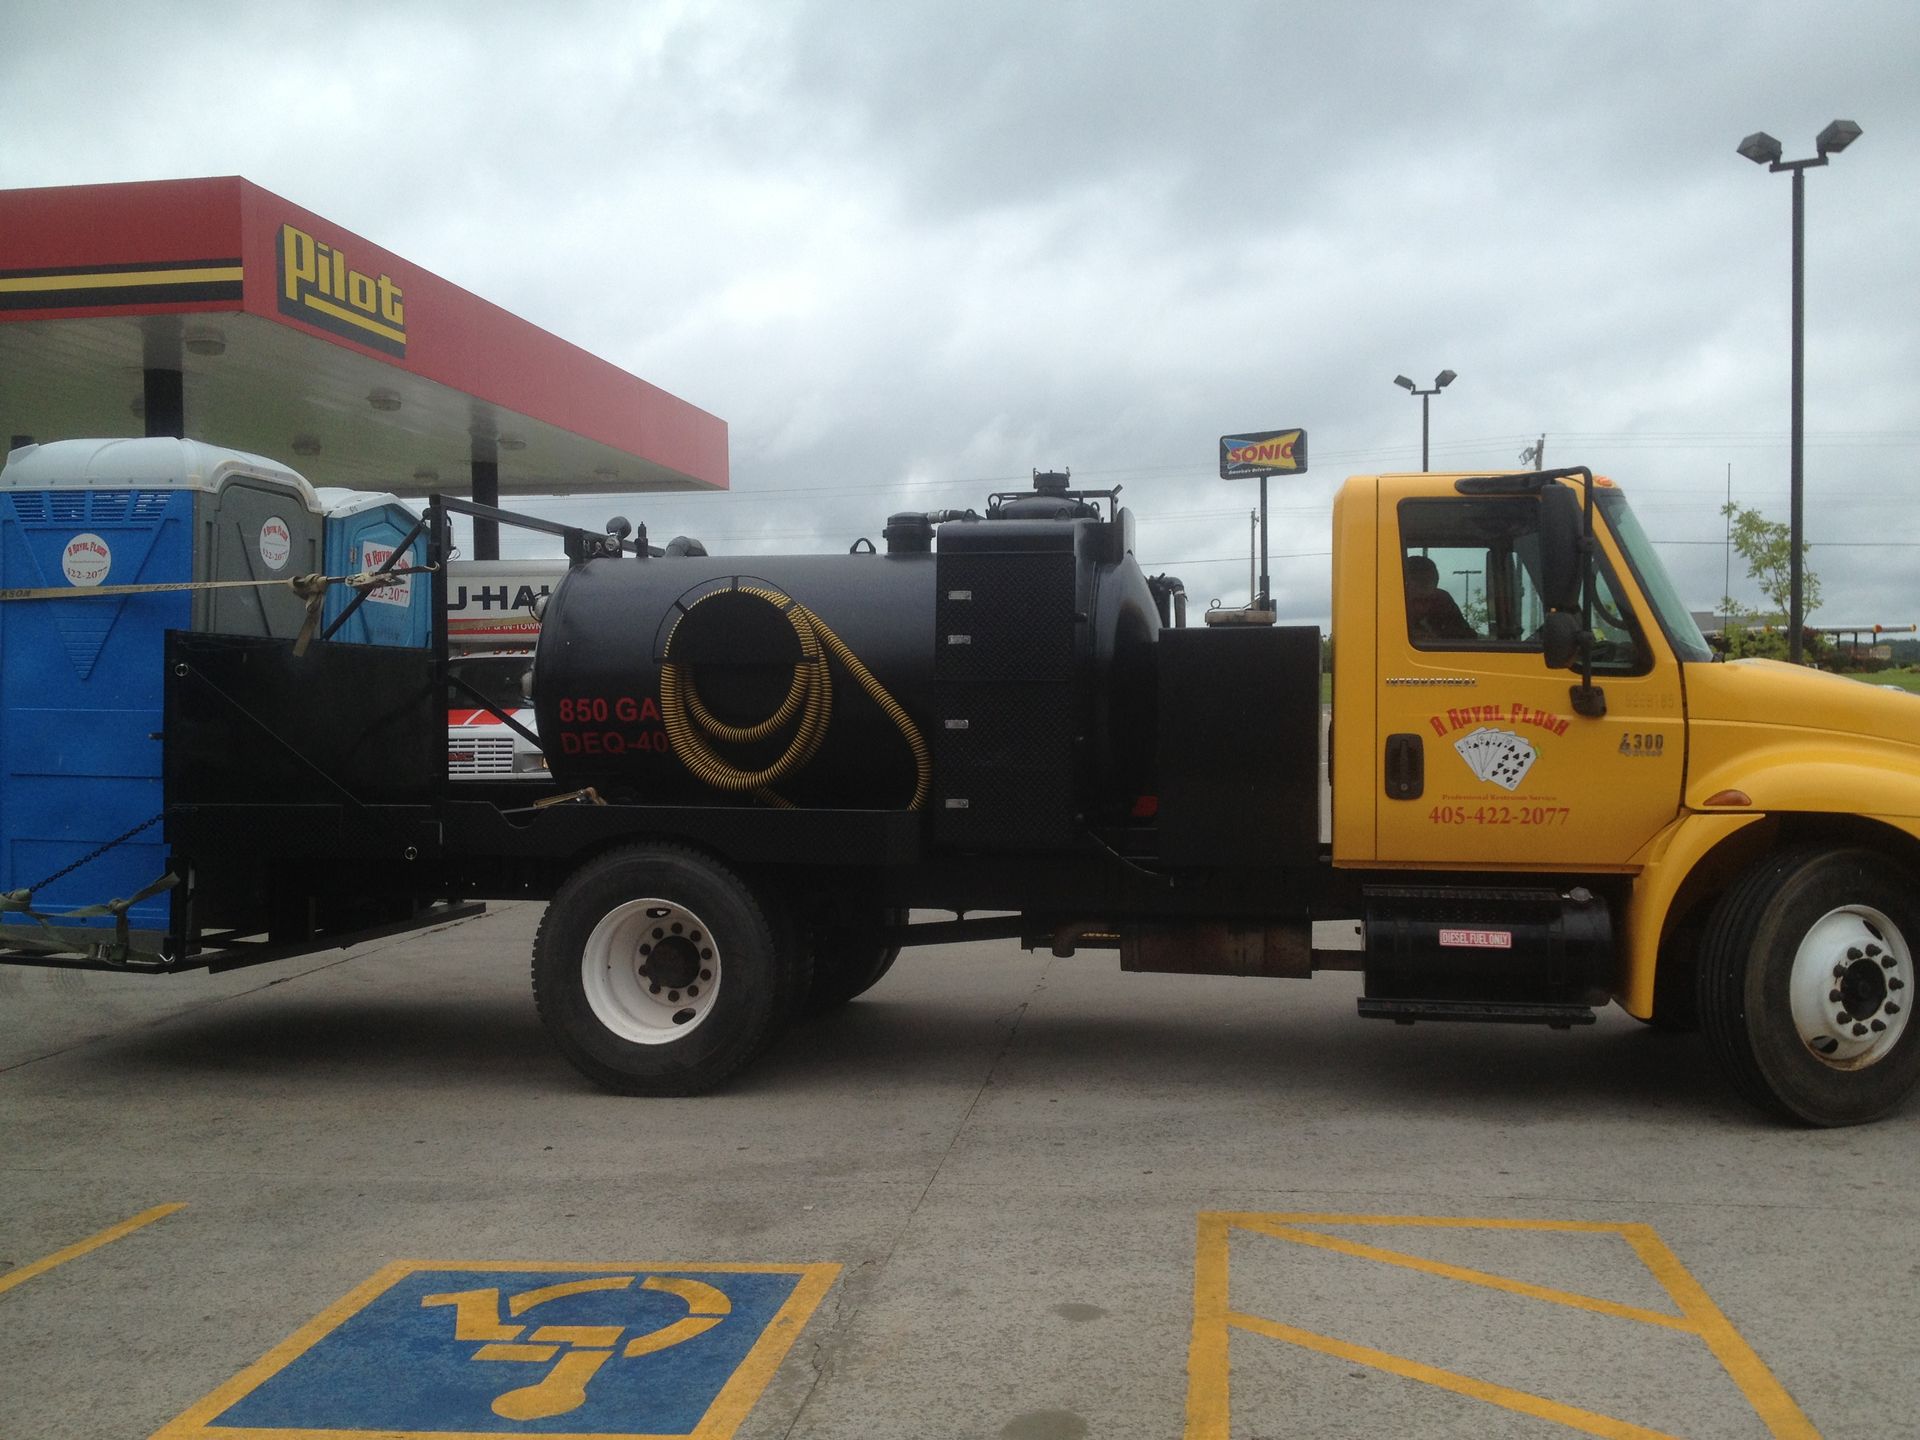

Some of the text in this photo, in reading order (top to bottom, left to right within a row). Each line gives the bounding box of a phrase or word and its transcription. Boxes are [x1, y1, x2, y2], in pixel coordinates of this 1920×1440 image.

[283, 223, 404, 326] Pilot
[1230, 442, 1295, 463] SONIC
[371, 586, 409, 602] 22-2077
[1386, 678, 1476, 687] INTERNATIONAL
[560, 697, 609, 722] 850
[1428, 805, 1570, 825] 405-422-2077
[1442, 931, 1508, 945] DIESEL FUEL ONLY
